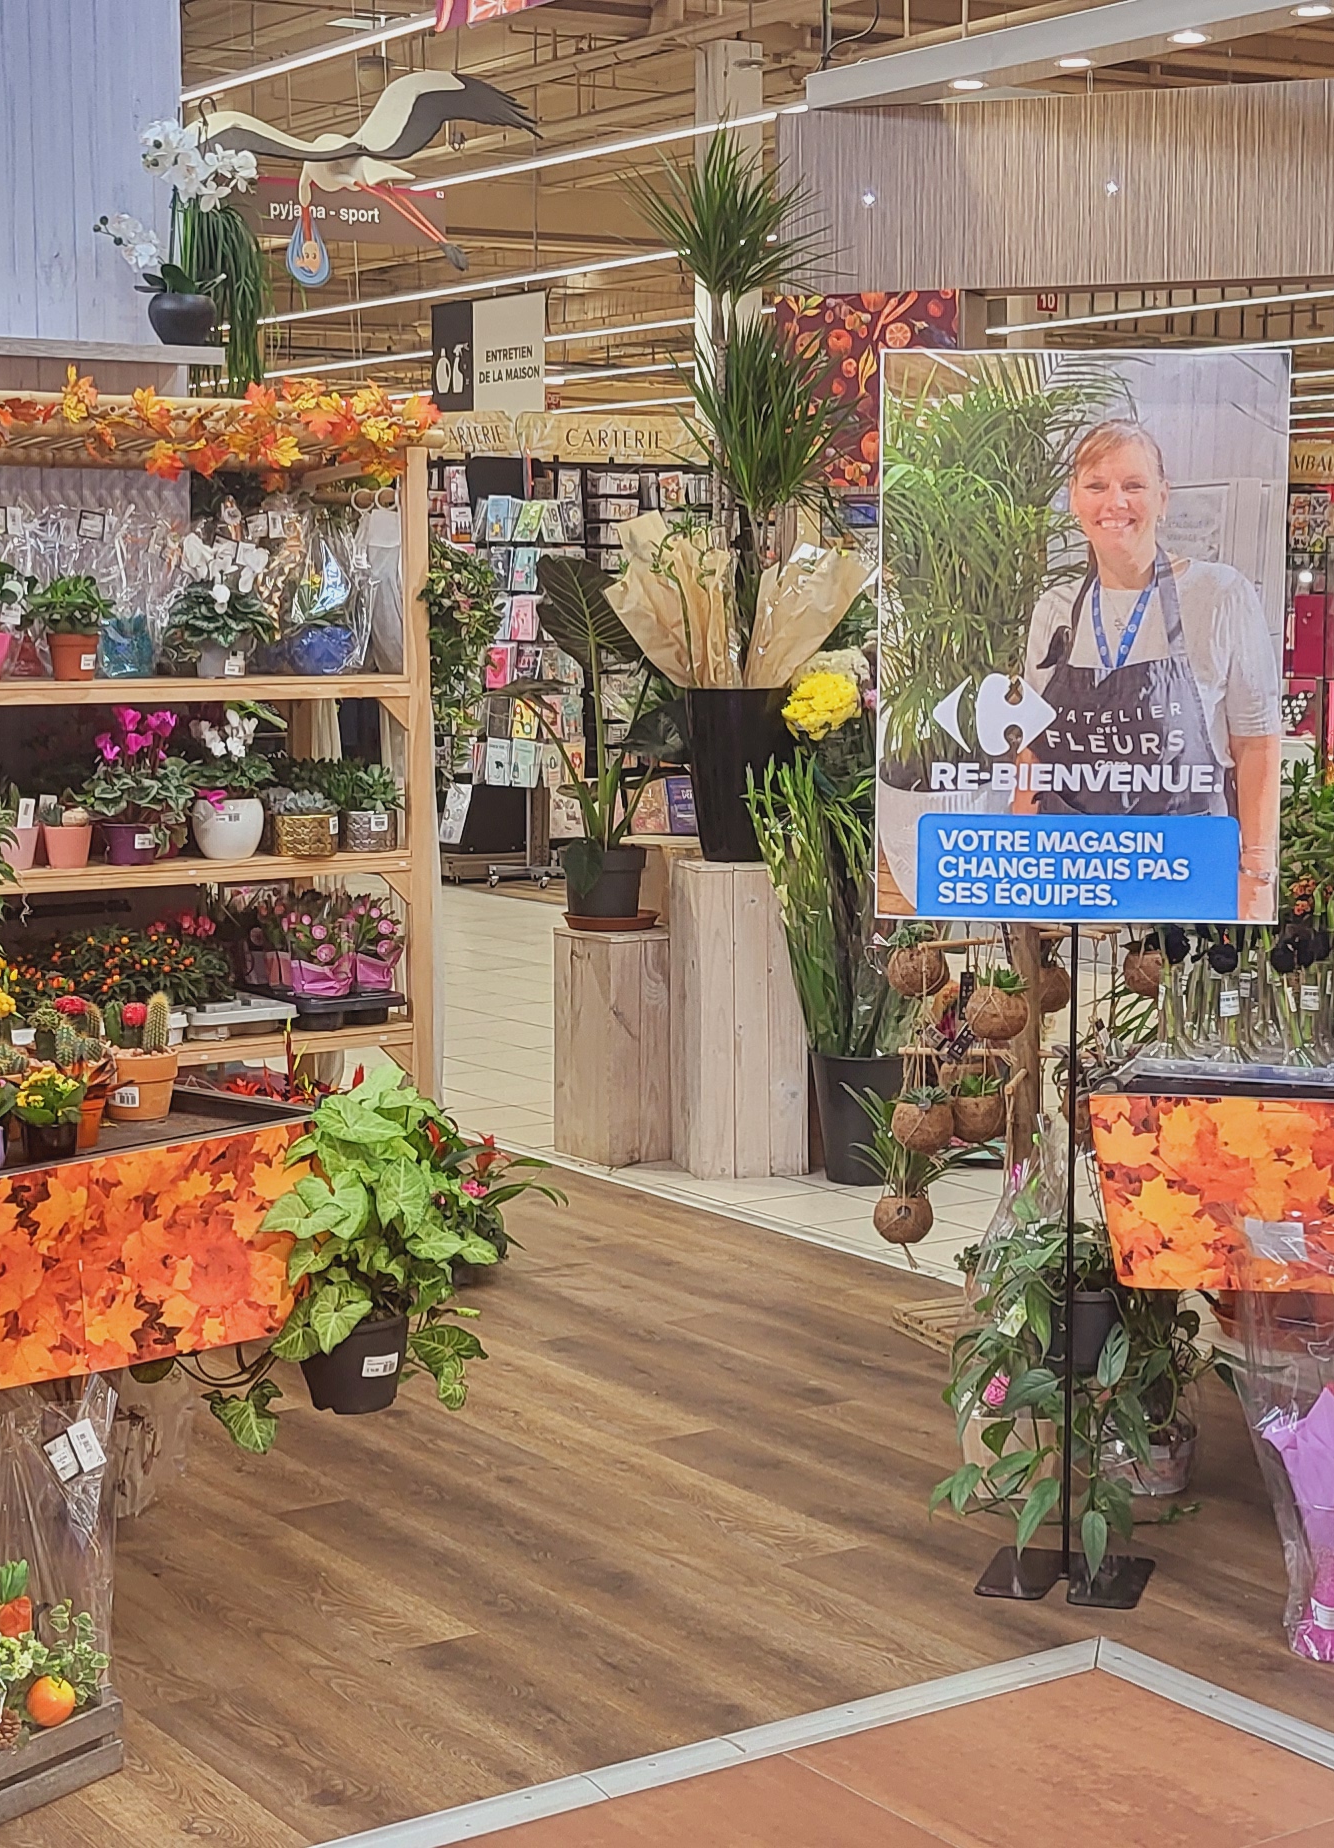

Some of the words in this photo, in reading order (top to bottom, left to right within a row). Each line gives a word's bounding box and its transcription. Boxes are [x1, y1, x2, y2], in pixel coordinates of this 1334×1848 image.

[339, 207, 380, 225] sport
[1040, 294, 1056, 309] 10
[485, 345, 533, 363] ENTRETIEN
[478, 372, 491, 384] DE
[492, 370, 504, 382] LA
[505, 365, 540, 381] MAISON
[448, 425, 504, 446] ARTERIE
[565, 428, 663, 449] CARTERIE
[1057, 702, 1182, 725] 'ATELIER
[1096, 726, 1117, 734] DES
[1045, 730, 1186, 756] FLEURS
[931, 762, 1223, 793] RE-BIENVENUE.
[938, 829, 1030, 852] VOTRE
[1037, 831, 1164, 854] MAGASIN
[938, 856, 1055, 879] CHANGE
[1062, 857, 1131, 880] MAIS
[1138, 858, 1189, 881] PAS
[938, 882, 988, 905] SES
[995, 878, 1118, 906] ÉQUIPES.
